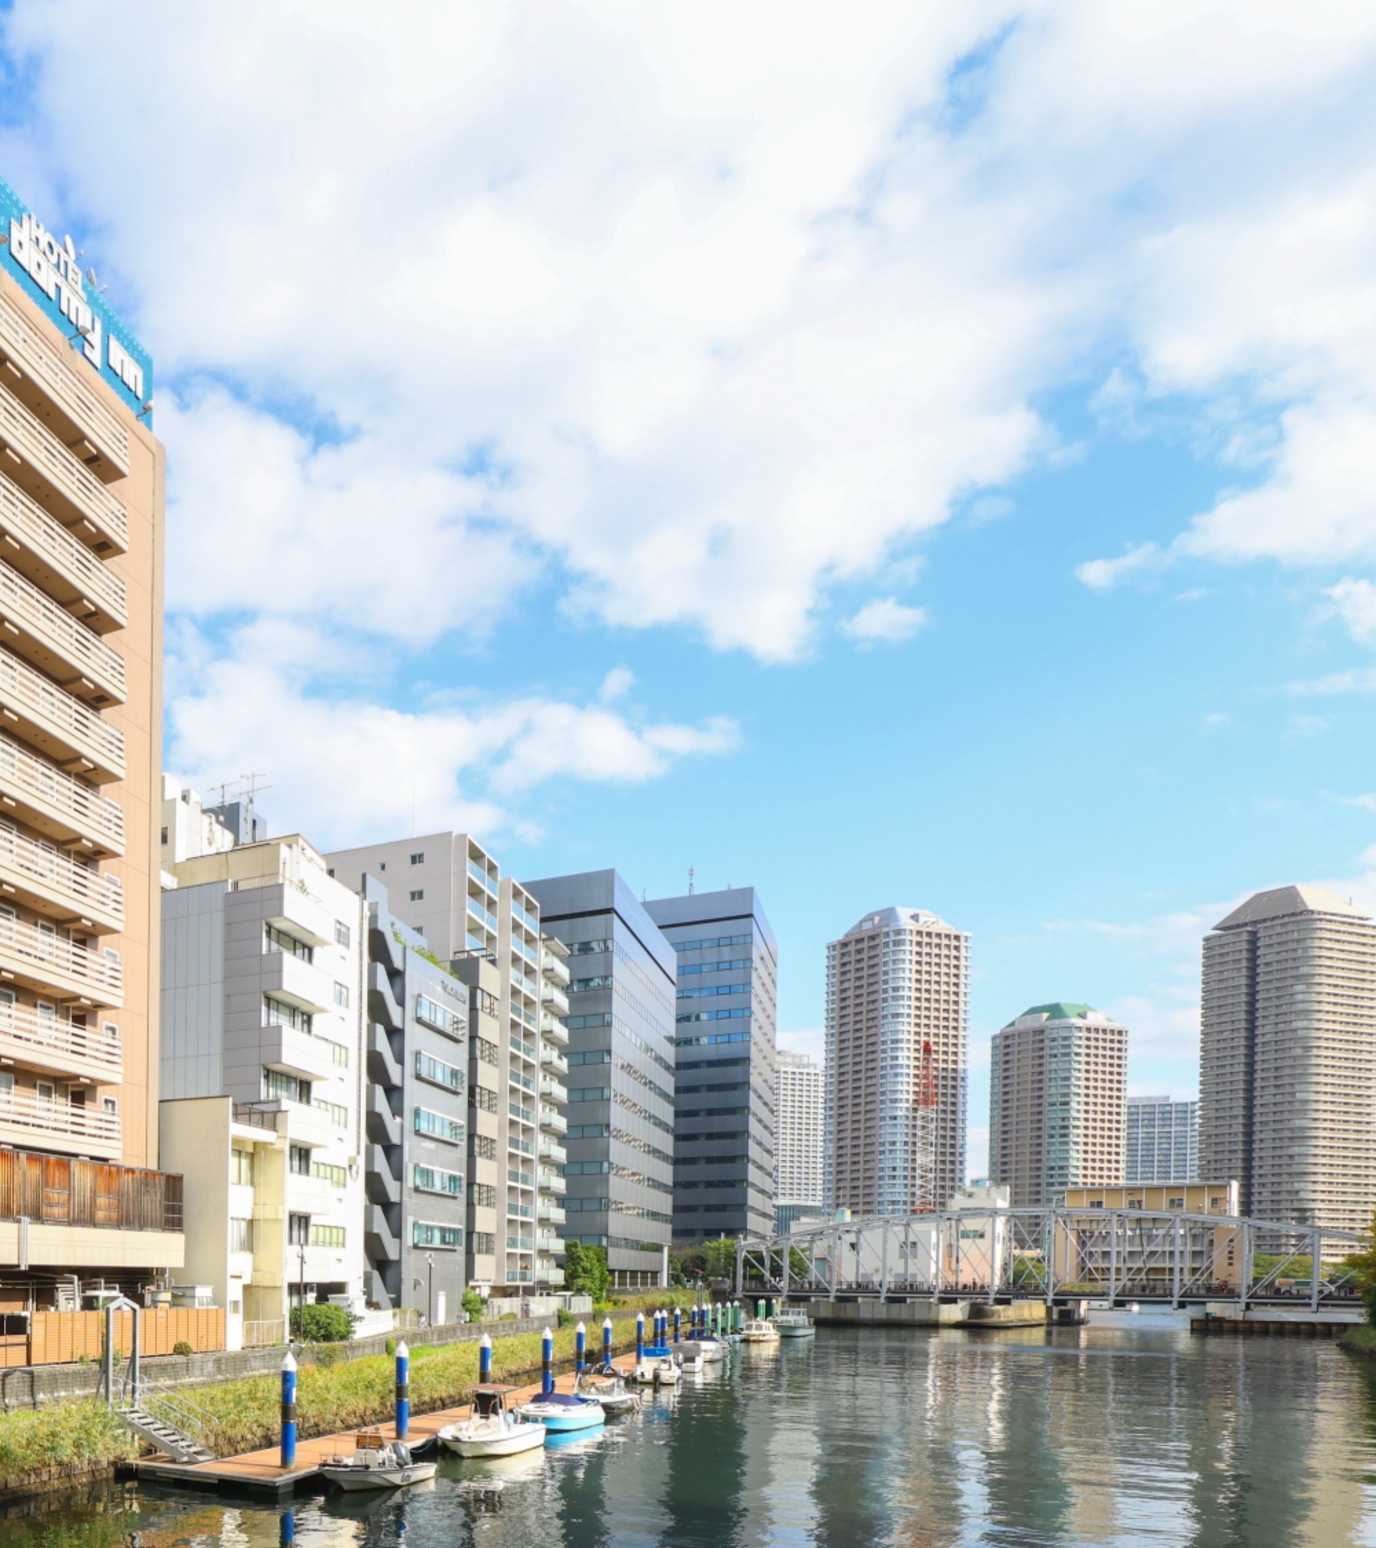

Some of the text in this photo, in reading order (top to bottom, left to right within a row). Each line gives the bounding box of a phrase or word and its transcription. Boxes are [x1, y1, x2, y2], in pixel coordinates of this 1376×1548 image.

[9, 213, 144, 400] dormy inn
[29, 213, 87, 302] HOTEL
